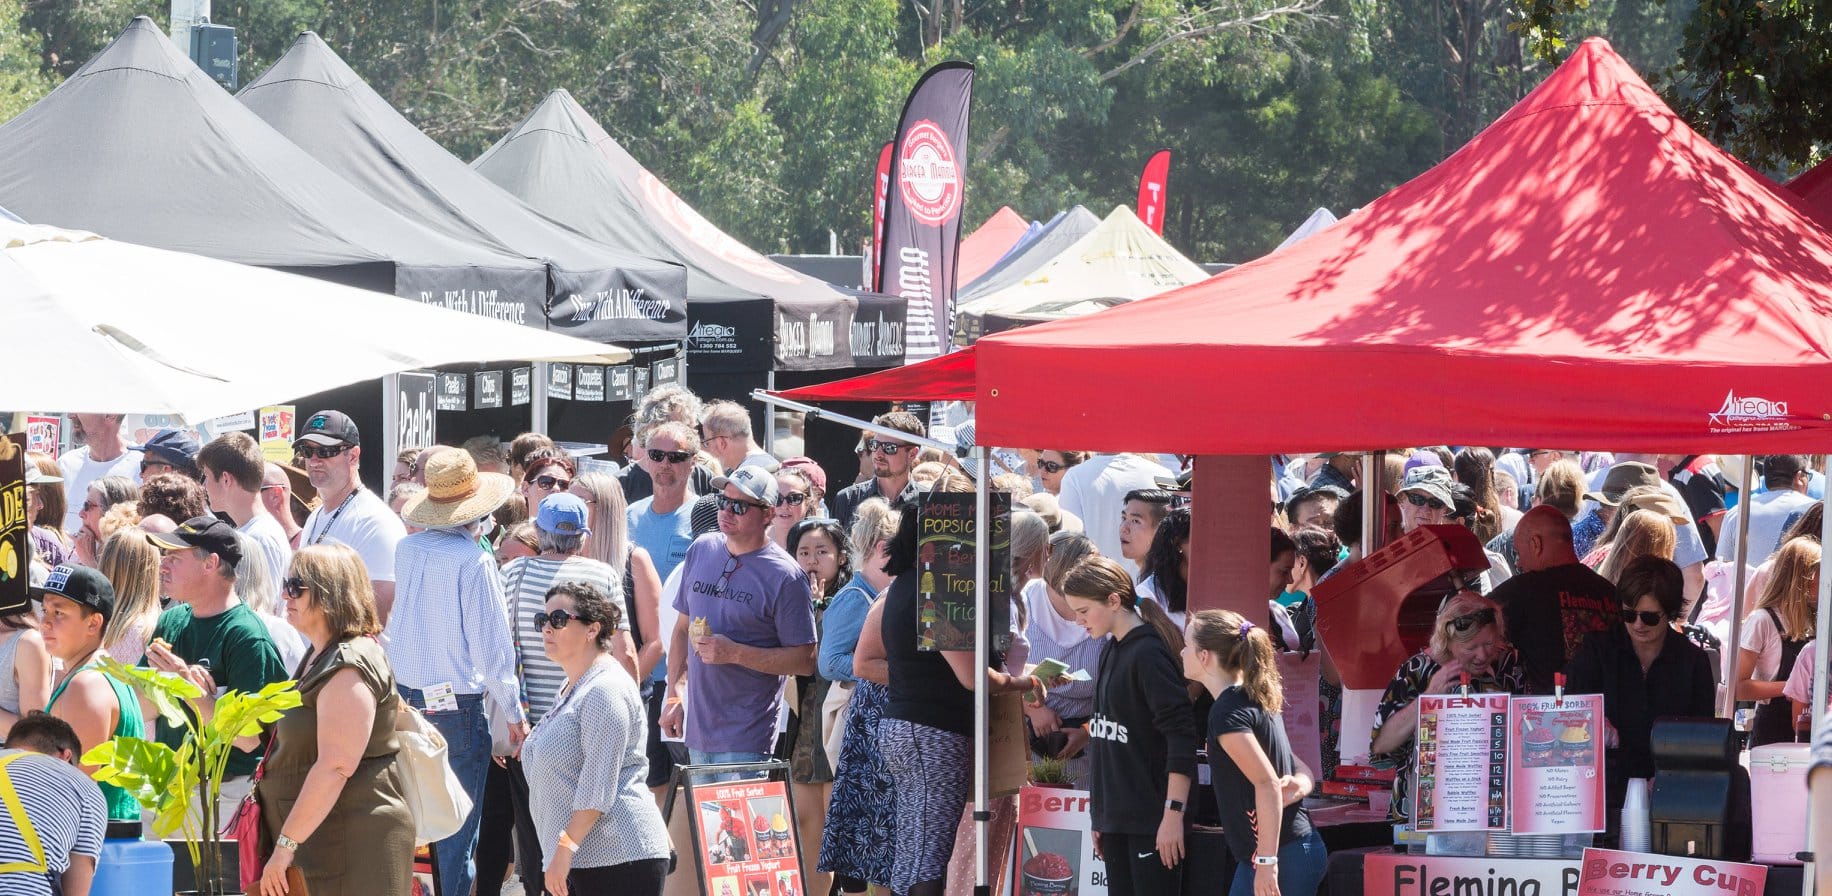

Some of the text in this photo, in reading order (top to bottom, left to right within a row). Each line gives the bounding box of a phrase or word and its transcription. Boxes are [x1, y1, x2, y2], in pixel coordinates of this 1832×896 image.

[471, 290, 476, 315] A
[478, 289, 525, 324] Difference
[569, 288, 671, 321] Dine With A Difference
[444, 375, 460, 395] Paella
[481, 375, 496, 396] Chips
[400, 391, 432, 450] Paella
[924, 503, 960, 516] HOME
[924, 518, 1003, 533] POPSICS
[947, 549, 977, 565] Ber
[942, 573, 1004, 597] Tropal
[1420, 697, 1506, 710] MENU
[1564, 701, 1594, 709] SORBET
[1495, 715, 1503, 724] 8
[1494, 740, 1501, 749] 5
[1494, 752, 1504, 760] 10
[1493, 766, 1502, 774] 12
[716, 787, 765, 798] 100% Fruit Sorbet
[1023, 793, 1090, 815] Berr
[1492, 817, 1499, 826] 9
[726, 863, 741, 874] Fruit
[742, 862, 760, 873] Frozen
[1584, 858, 1683, 886] Berry
